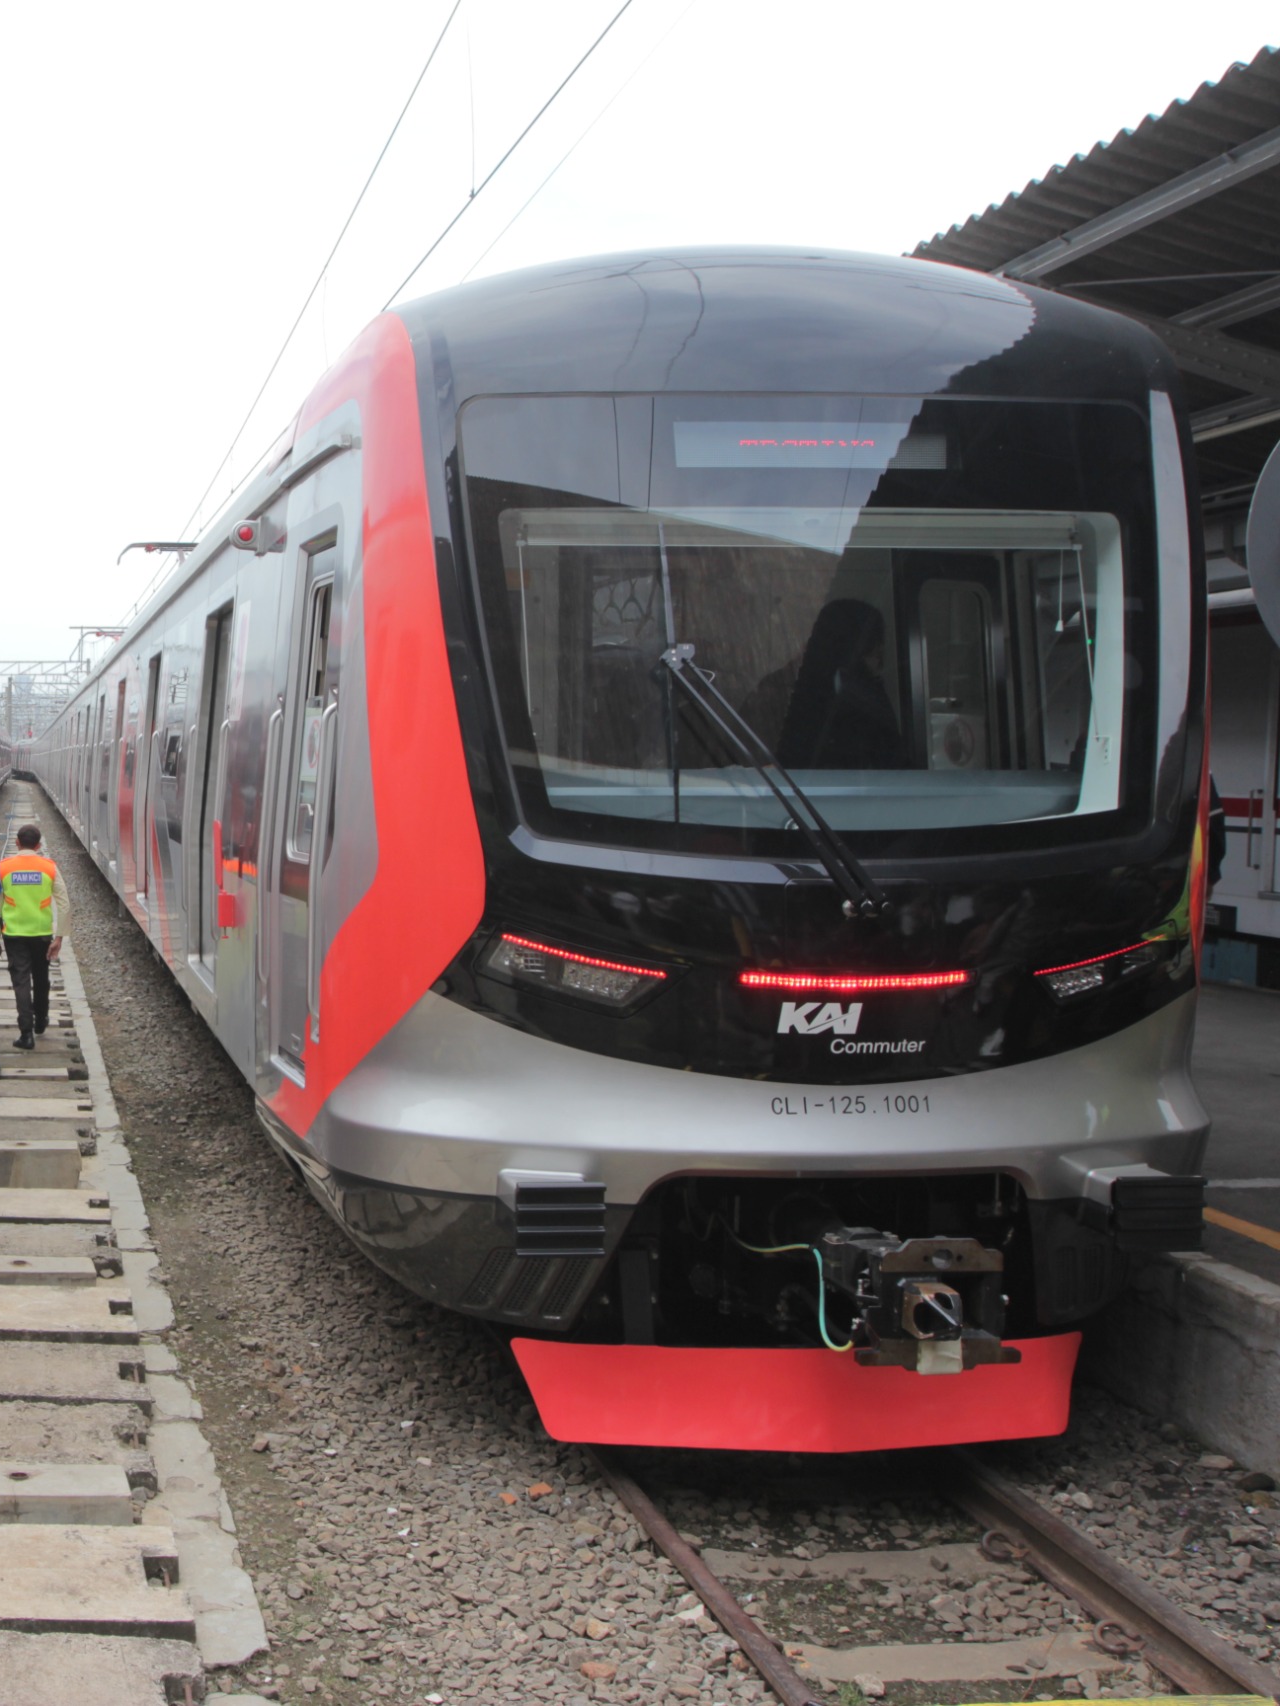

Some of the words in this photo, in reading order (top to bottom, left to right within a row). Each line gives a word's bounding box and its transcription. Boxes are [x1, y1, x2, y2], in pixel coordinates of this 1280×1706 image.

[777, 1002, 863, 1034] KAI
[830, 1038, 926, 1055] Commuter
[771, 1095, 931, 1115] CLI-125.1001
